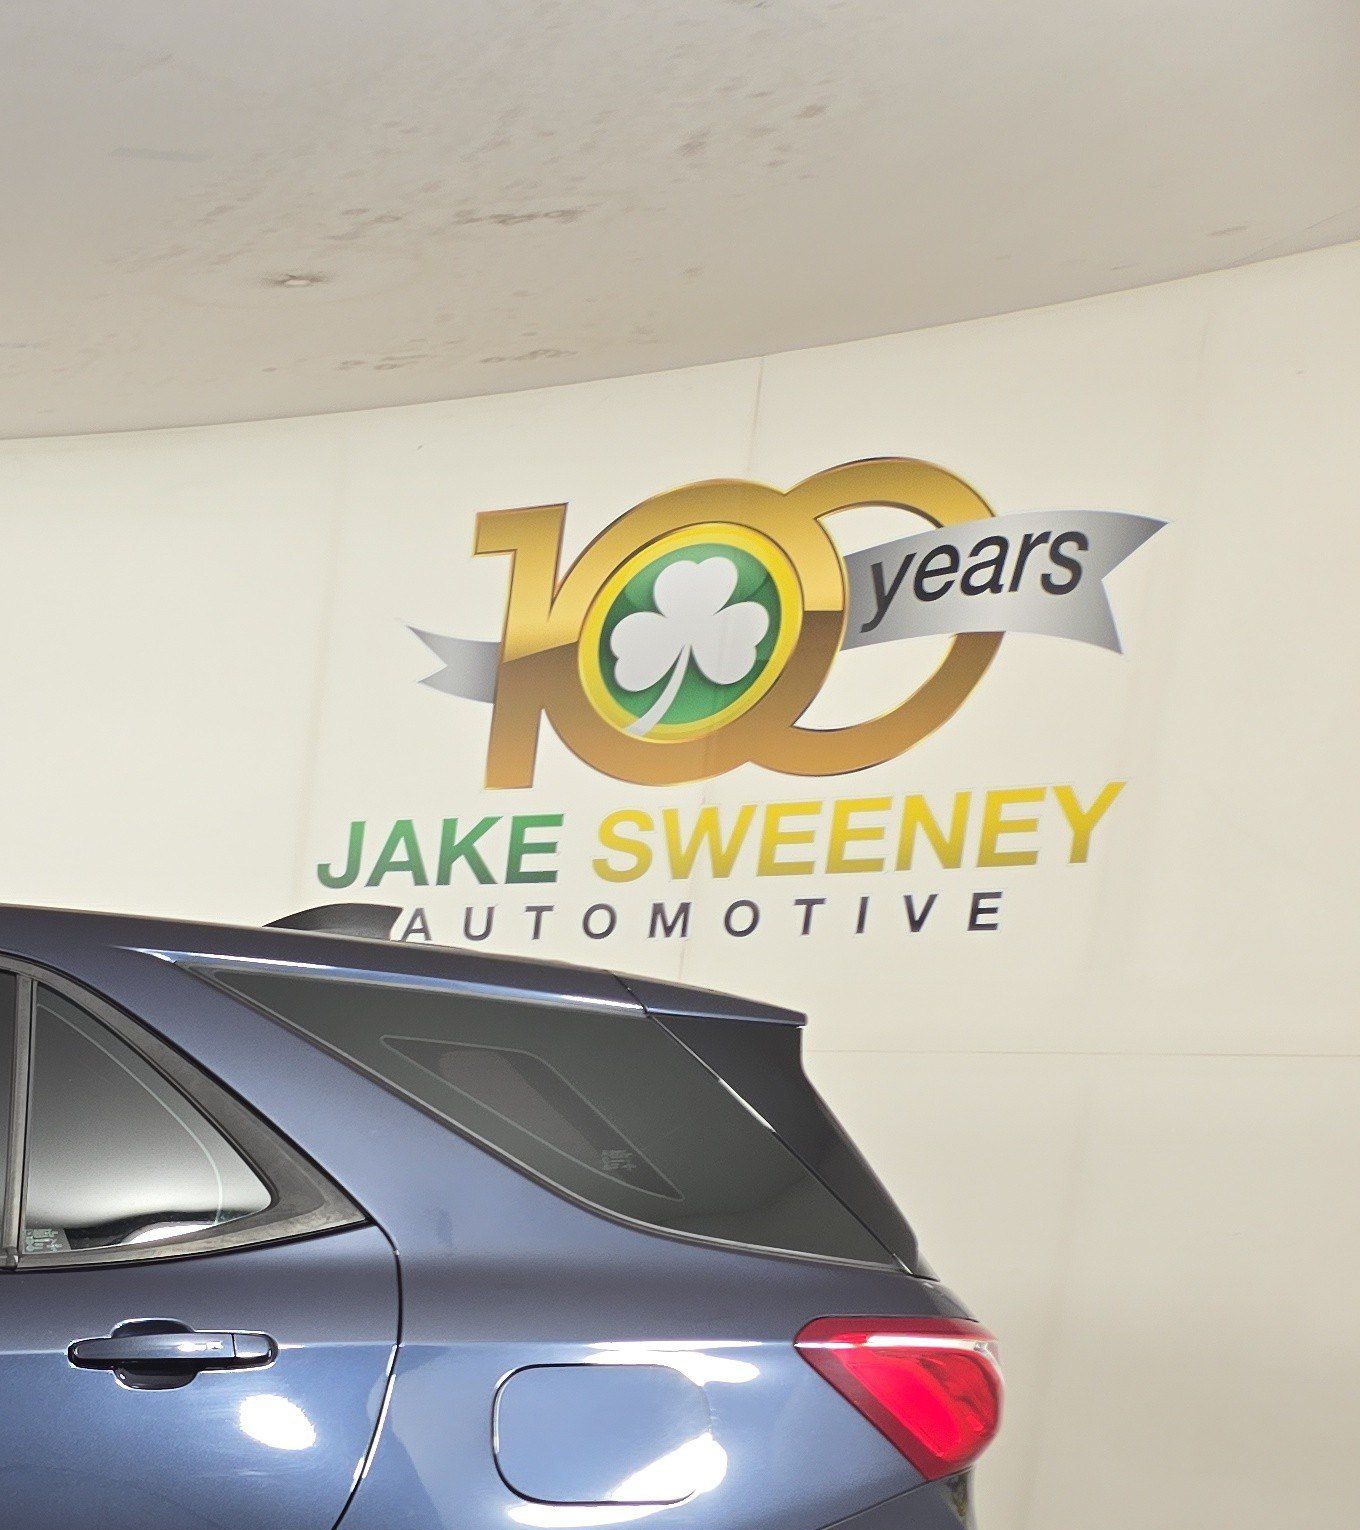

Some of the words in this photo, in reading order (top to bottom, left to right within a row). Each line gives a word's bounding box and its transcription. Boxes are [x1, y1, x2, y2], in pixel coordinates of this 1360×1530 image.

[860, 527, 1088, 631] years
[316, 812, 566, 890] JAKE
[592, 781, 1126, 883] SWEENEY
[400, 890, 1004, 943] AUTOMOTIVE
